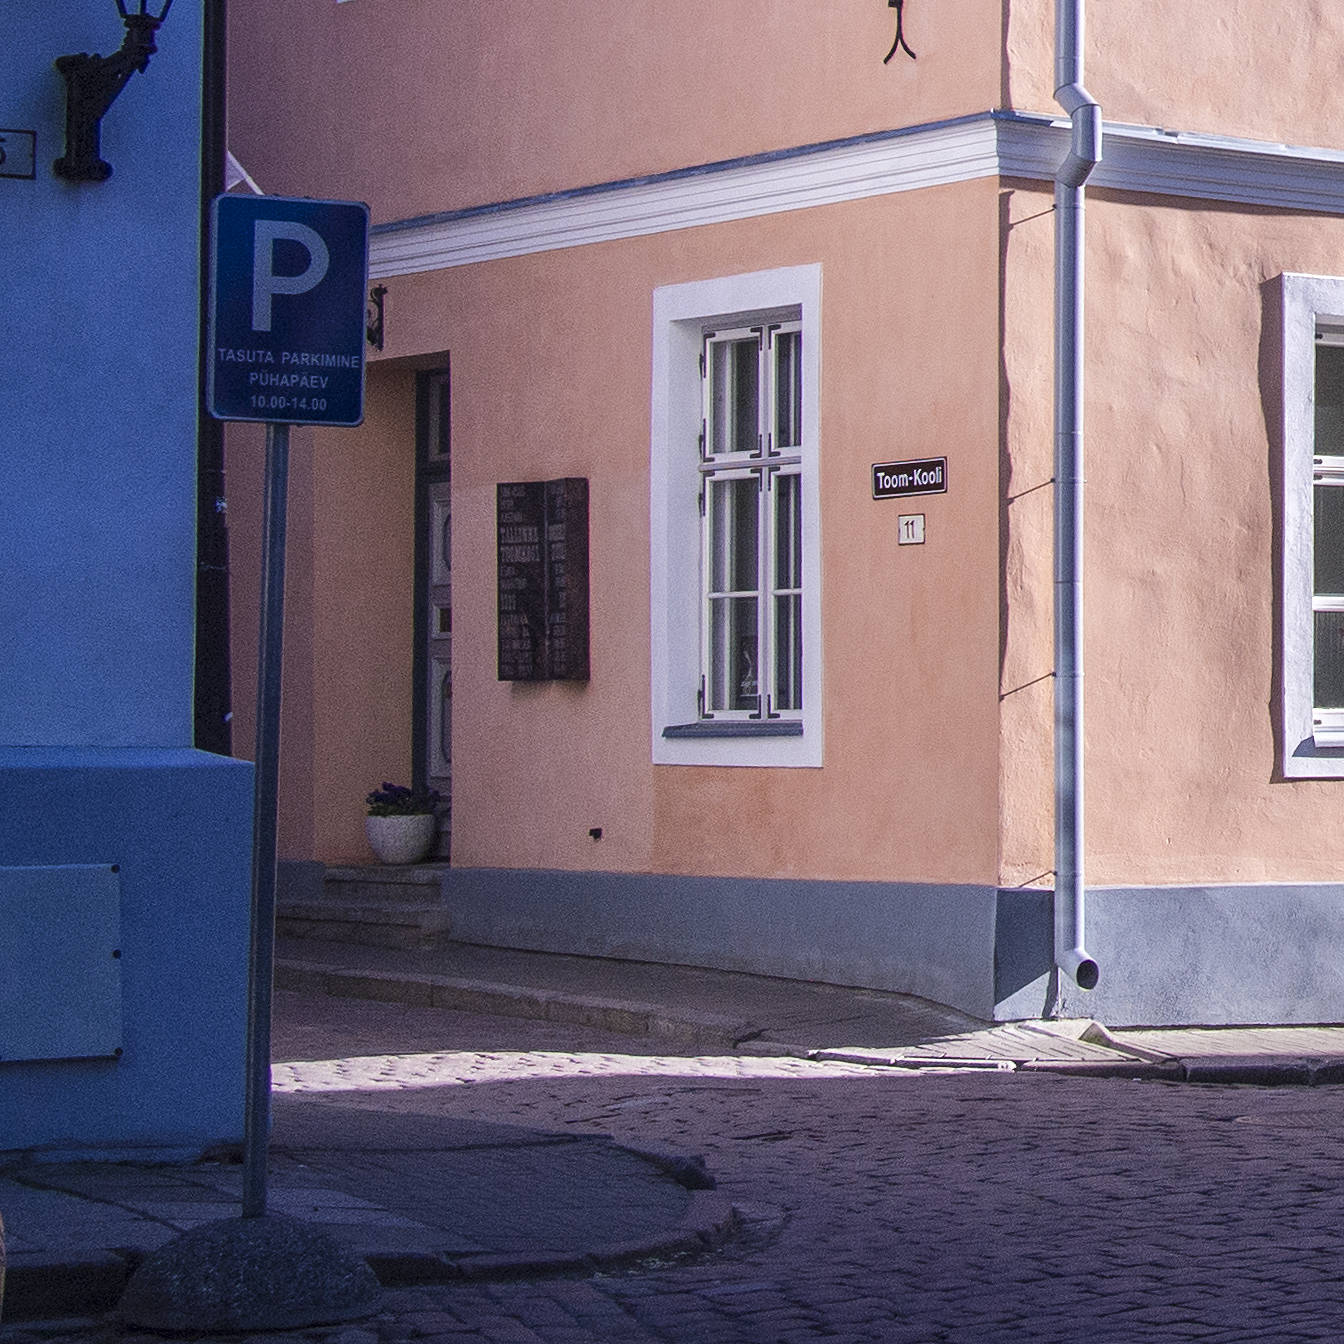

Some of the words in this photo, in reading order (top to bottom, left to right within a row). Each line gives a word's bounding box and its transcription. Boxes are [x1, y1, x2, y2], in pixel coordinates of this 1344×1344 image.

[252, 218, 331, 333] P
[217, 347, 275, 364] TASUTA
[281, 351, 360, 369] PARKIMINE
[249, 368, 330, 389] PÜHAPÄEV
[250, 395, 328, 411] 10.00-14.00
[876, 466, 943, 489] Toom-Kooli
[904, 519, 916, 539] 11
